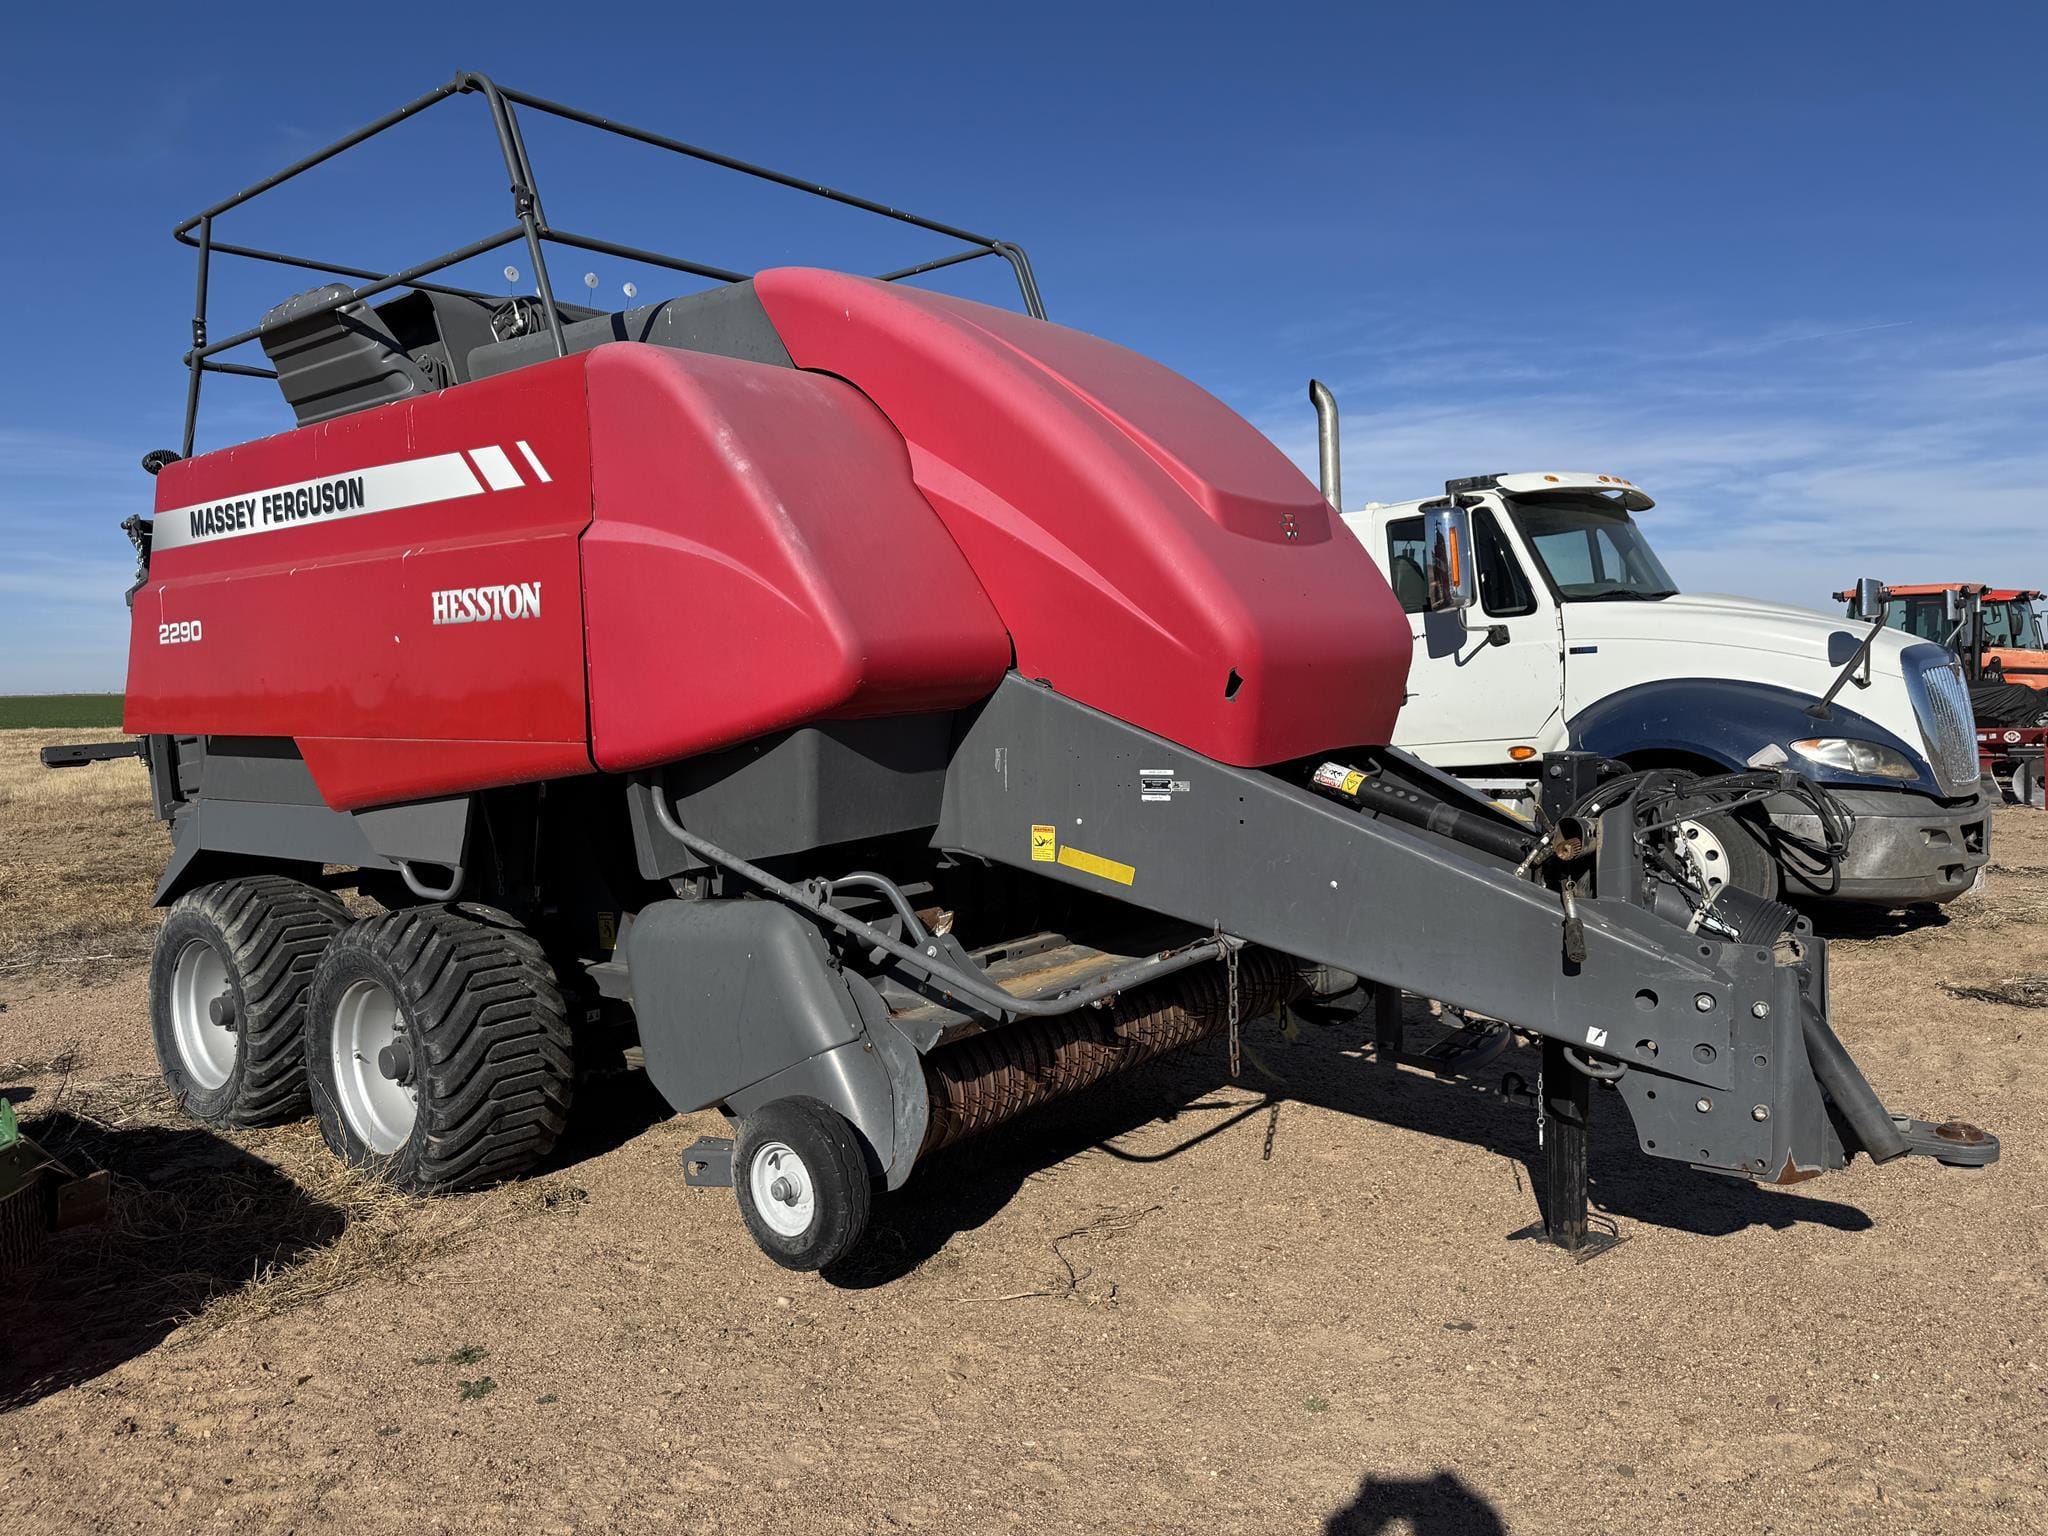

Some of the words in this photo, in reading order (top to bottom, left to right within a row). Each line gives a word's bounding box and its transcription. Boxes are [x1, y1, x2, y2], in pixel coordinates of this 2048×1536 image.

[190, 498, 256, 538] MASSEY
[262, 476, 365, 524] FERGUSON
[431, 582, 542, 625] HESSTON
[159, 619, 202, 645] 2290
